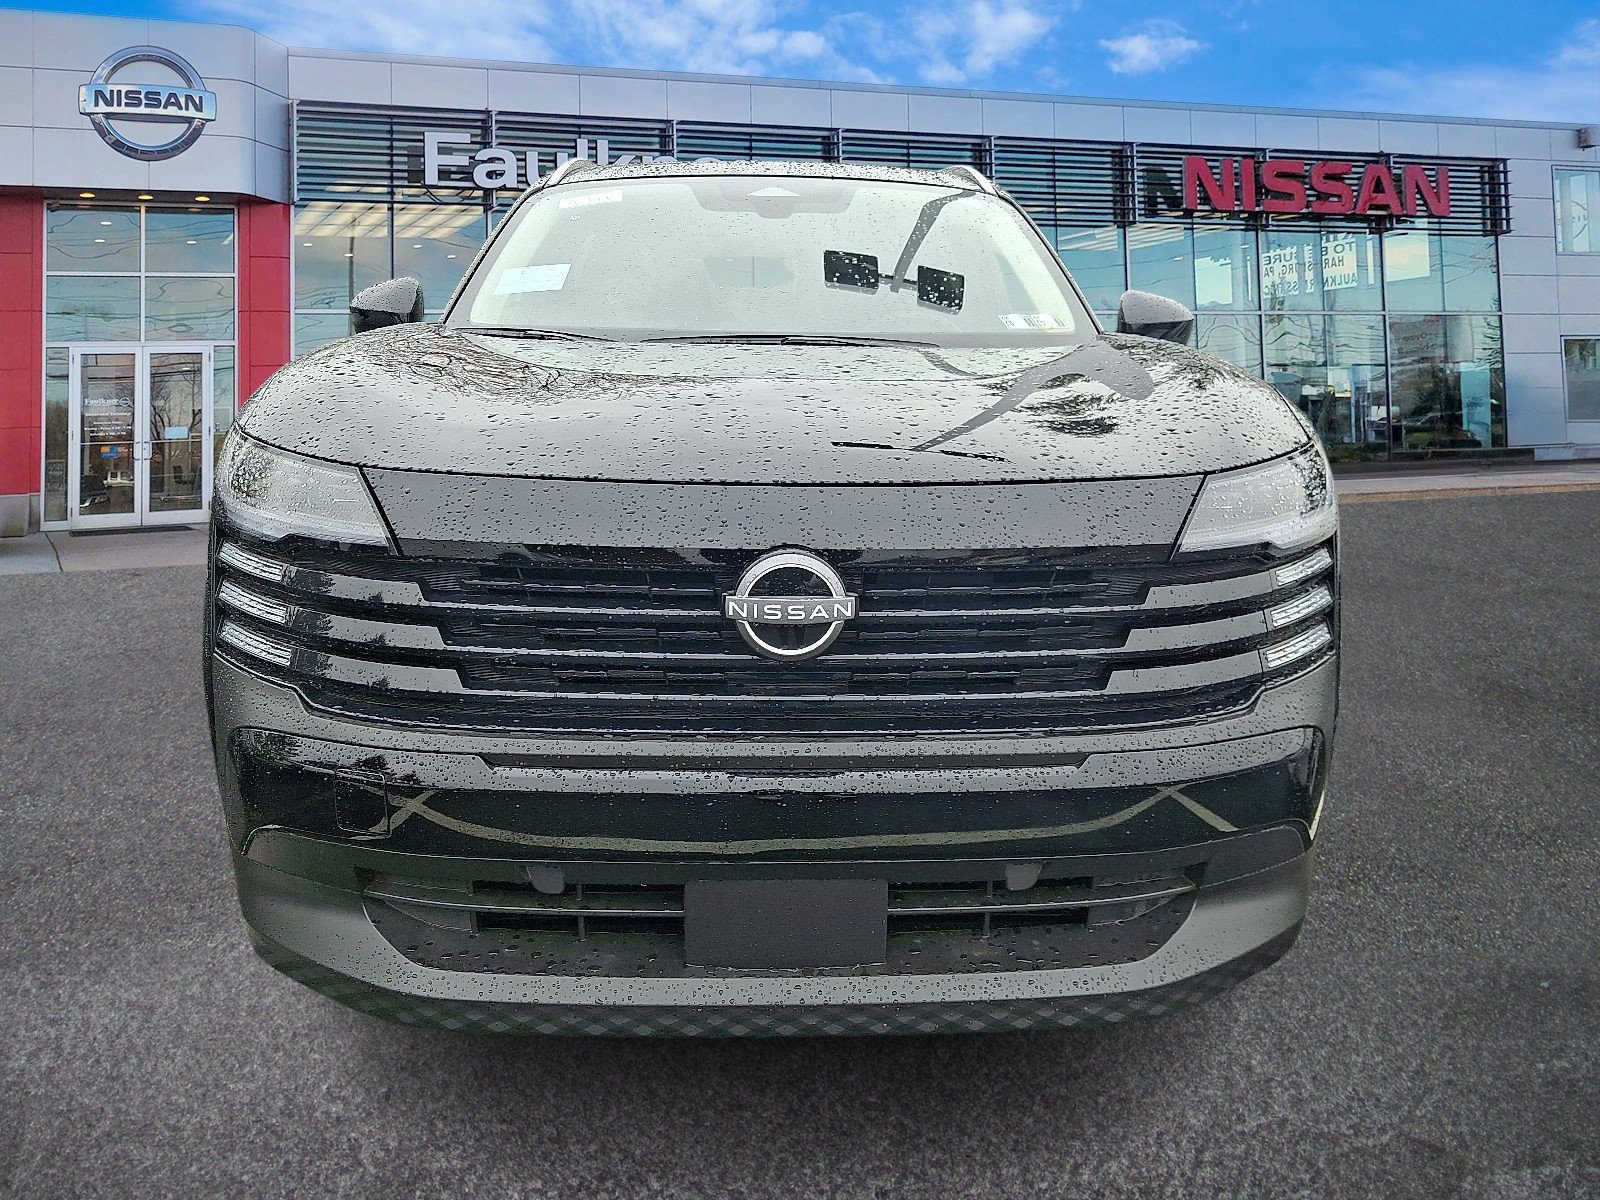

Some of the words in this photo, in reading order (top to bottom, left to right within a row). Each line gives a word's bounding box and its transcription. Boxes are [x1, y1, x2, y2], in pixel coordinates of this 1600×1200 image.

[94, 89, 204, 113] NISSAN
[1183, 155, 1450, 217] NISSAN
[728, 601, 852, 620] NISSAN
